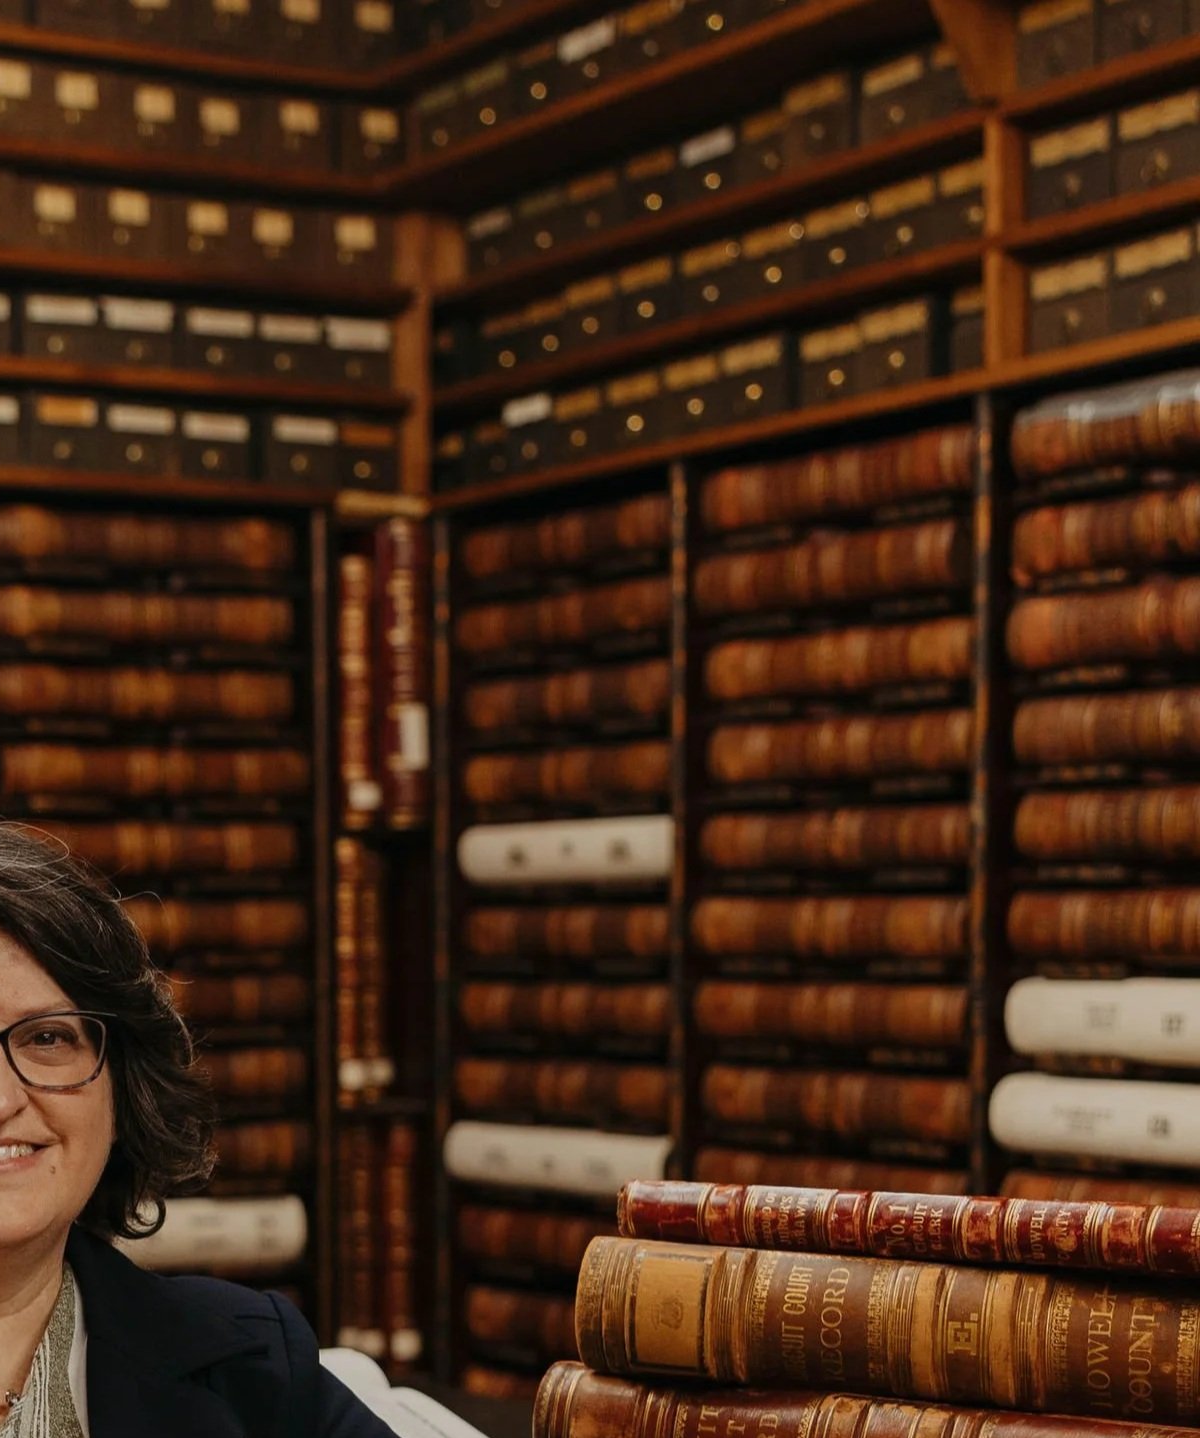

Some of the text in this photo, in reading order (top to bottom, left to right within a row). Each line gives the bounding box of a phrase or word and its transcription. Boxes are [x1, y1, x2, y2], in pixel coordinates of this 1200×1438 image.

[888, 1203, 910, 1213] 1
[1055, 1209, 1071, 1261] CUNTY
[782, 1265, 814, 1315] COURT
[820, 1267, 850, 1382] RECORD
[1128, 1299, 1157, 1413] COUNT
